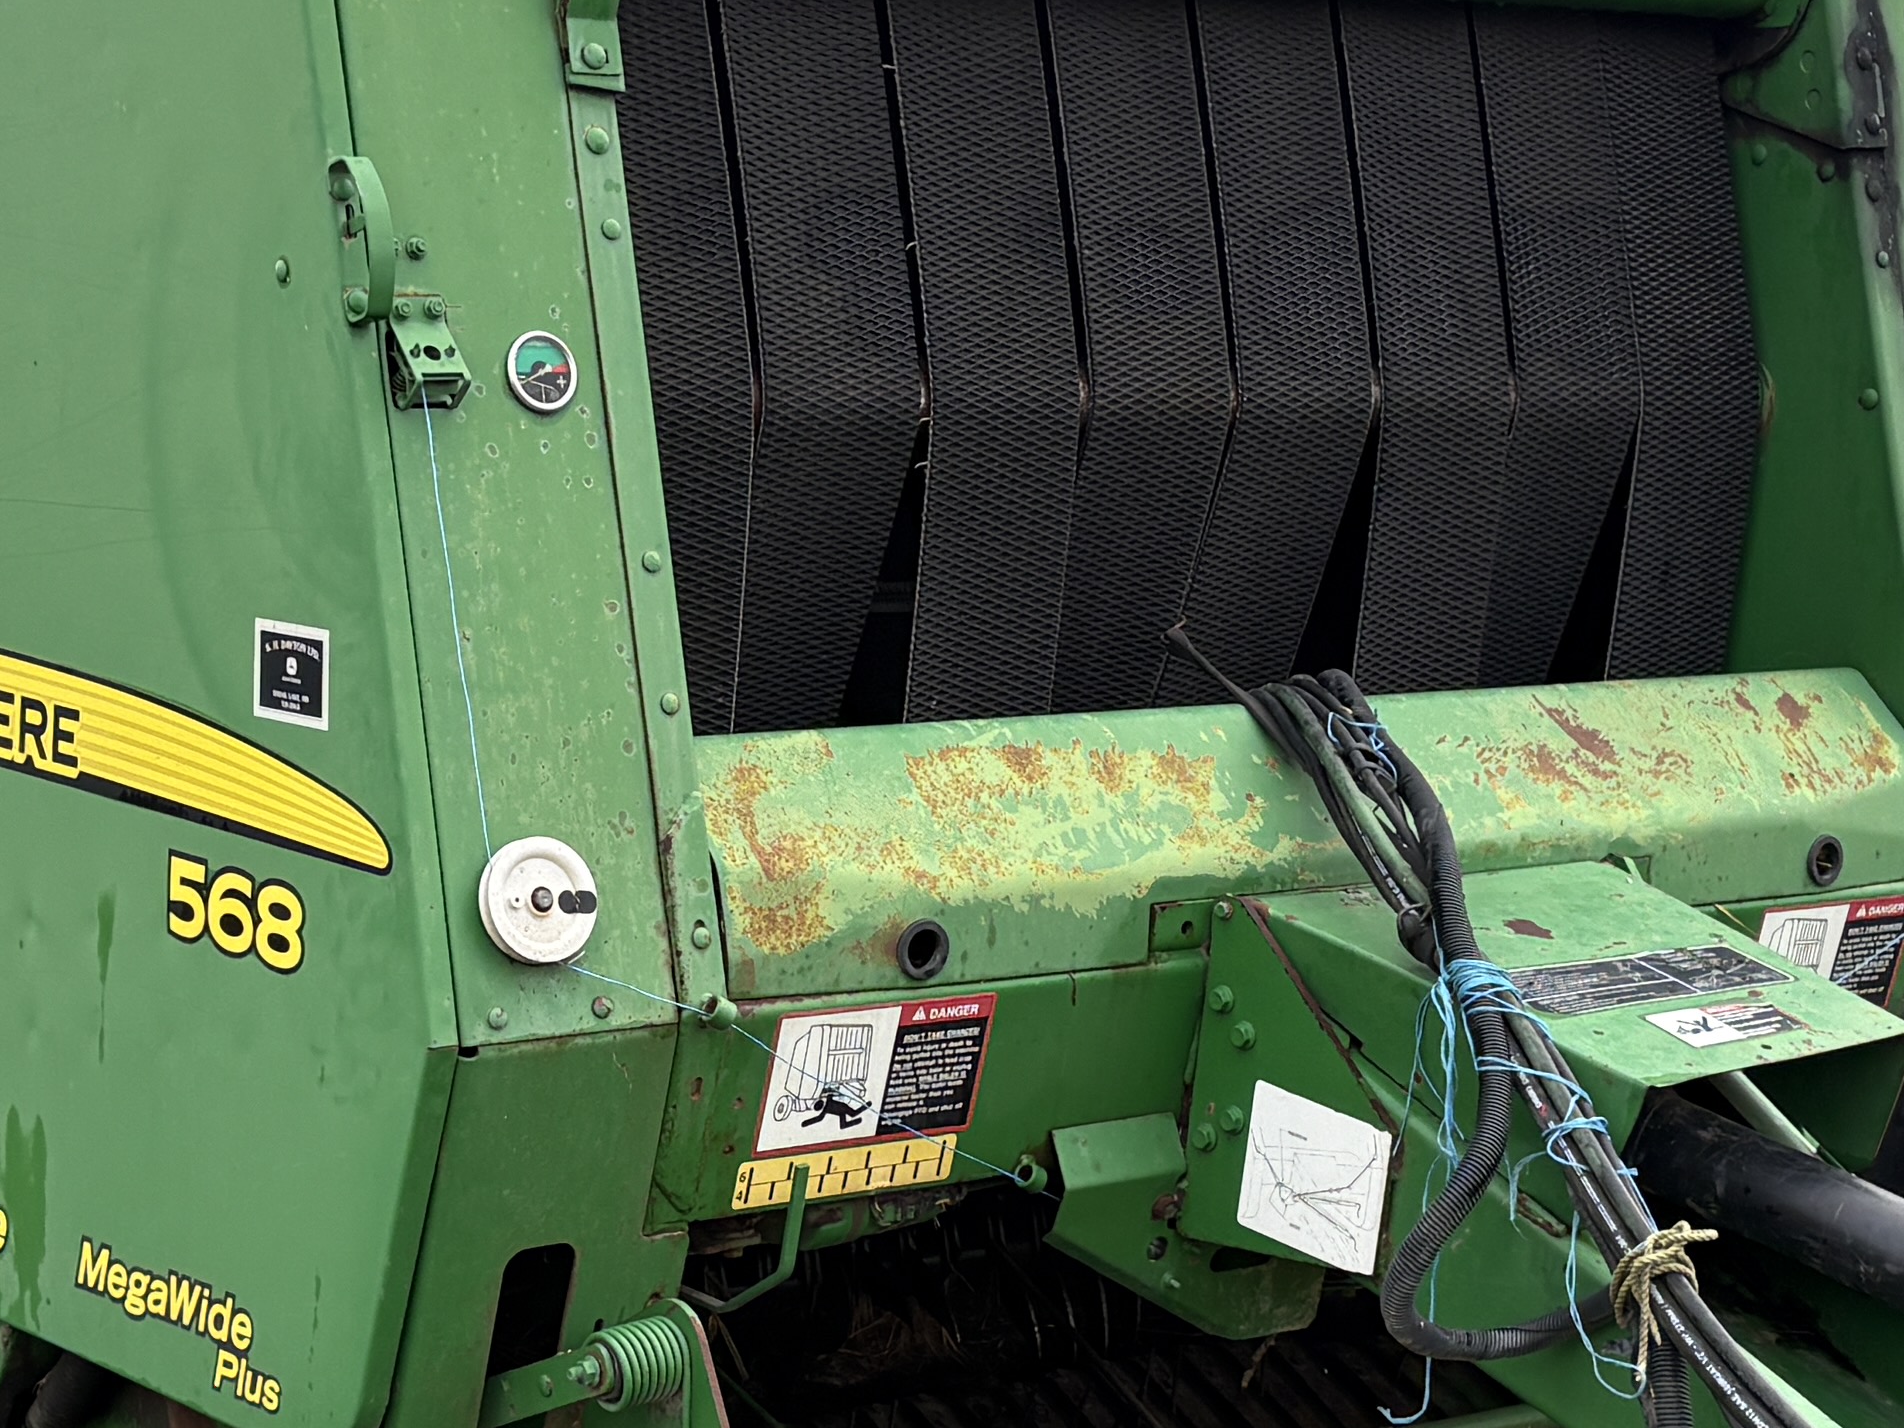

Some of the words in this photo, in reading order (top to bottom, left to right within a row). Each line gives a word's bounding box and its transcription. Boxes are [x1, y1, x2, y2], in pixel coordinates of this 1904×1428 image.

[169, 850, 304, 972] 568
[929, 1004, 979, 1020] DANGER
[738, 1171, 747, 1183] 6
[76, 1238, 253, 1352] MegaWide
[213, 1348, 281, 1413] Plus
